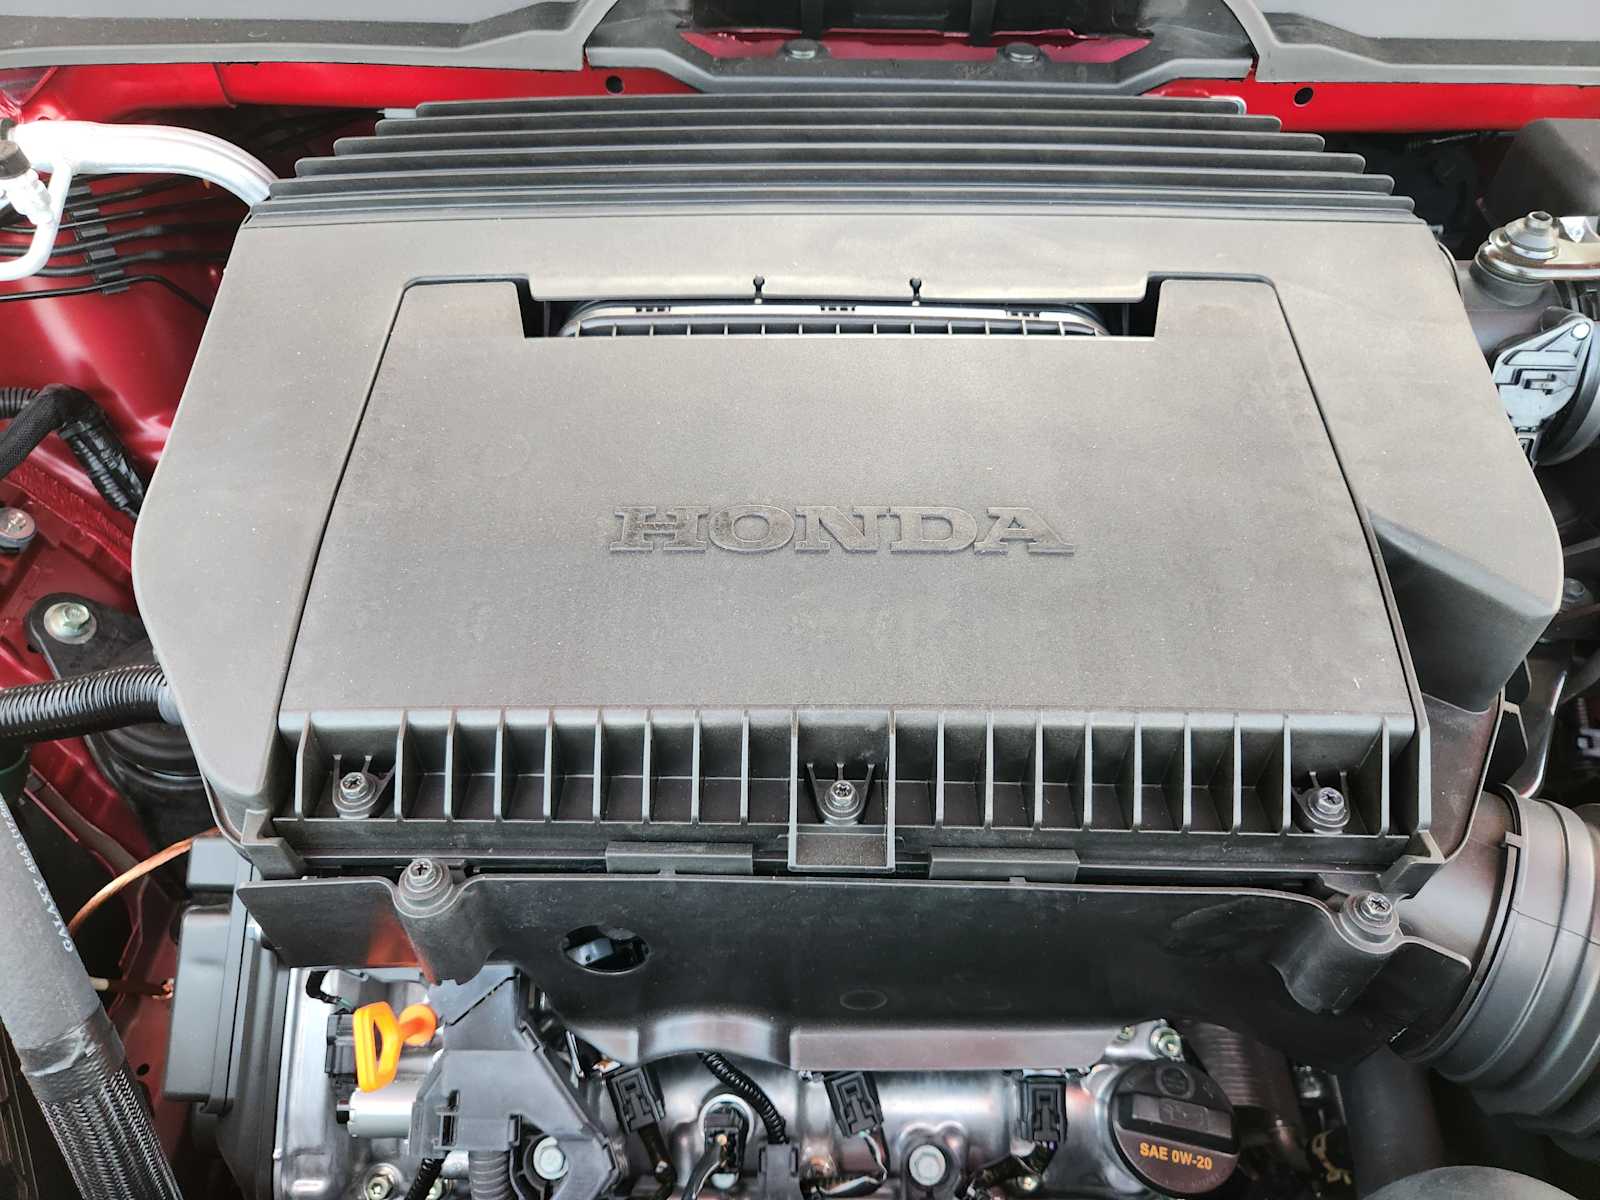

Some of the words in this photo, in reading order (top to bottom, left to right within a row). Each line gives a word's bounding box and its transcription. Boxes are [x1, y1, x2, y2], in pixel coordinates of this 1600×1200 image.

[609, 504, 1075, 555] HONDA
[33, 878, 73, 952] GALAXY
[1139, 1142, 1168, 1160] SAE
[1171, 1149, 1213, 1170] 0W-20
